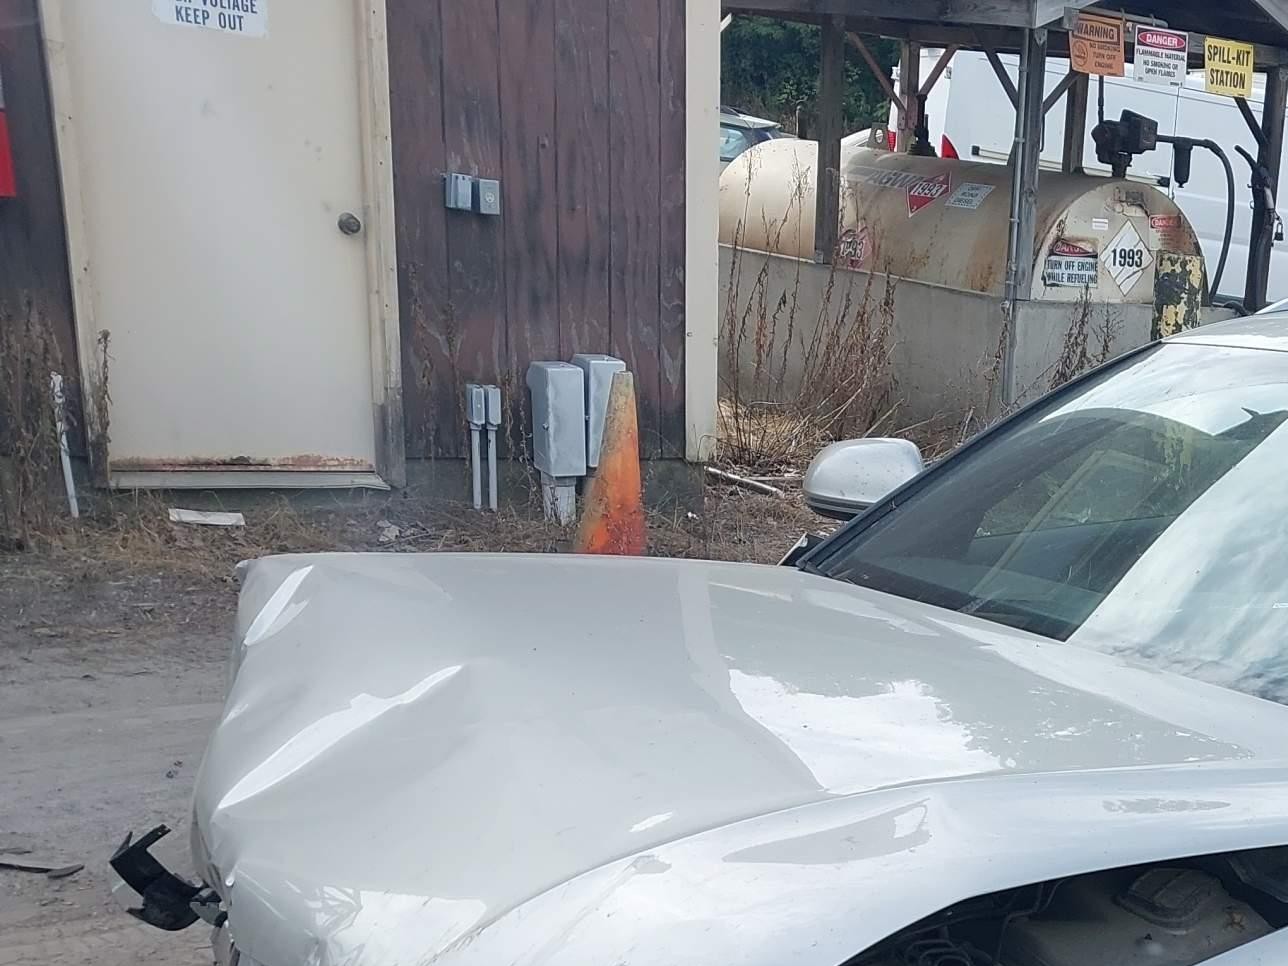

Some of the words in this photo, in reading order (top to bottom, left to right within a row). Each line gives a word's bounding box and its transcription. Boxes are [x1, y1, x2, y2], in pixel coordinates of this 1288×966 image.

[175, 5, 210, 26] KEEP
[218, 12, 244, 31] OUT
[1077, 23, 1115, 40] WARNING
[1146, 33, 1178, 48] DANGER
[1207, 44, 1251, 67] SPILL-KIT
[1209, 67, 1246, 90] STATION
[914, 182, 943, 197] 1993
[1047, 260, 1062, 270] TURN
[1064, 261, 1076, 271] OFF
[1077, 262, 1098, 272] ENGINE
[1111, 248, 1144, 268] 1993
[1066, 273, 1098, 284] REFUELING
